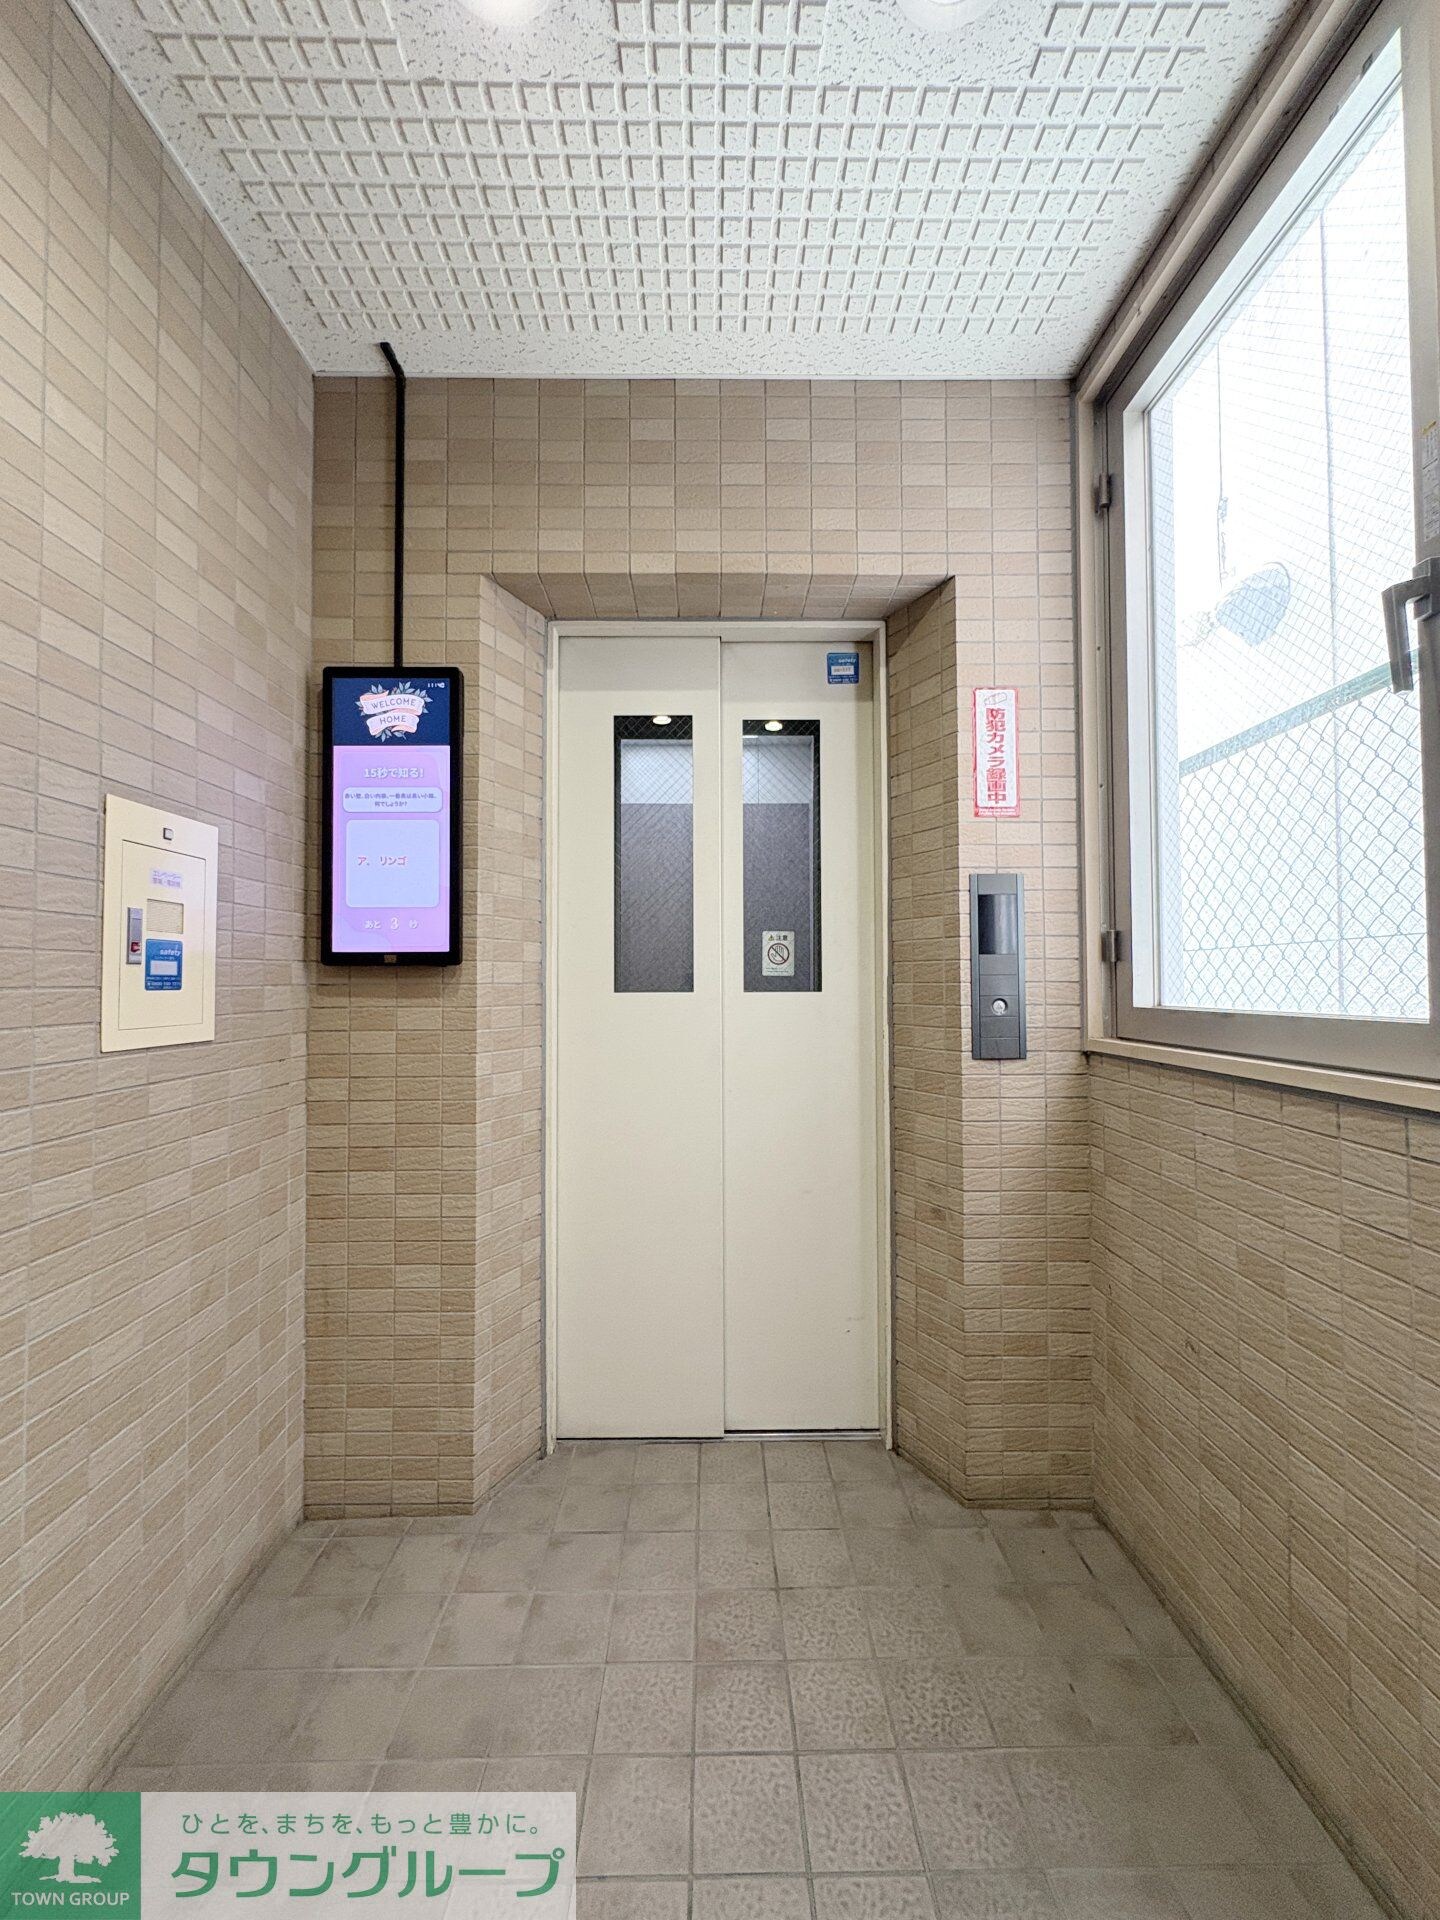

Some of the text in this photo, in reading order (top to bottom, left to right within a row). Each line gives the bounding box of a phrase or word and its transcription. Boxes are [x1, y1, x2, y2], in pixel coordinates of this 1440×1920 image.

[371, 698, 416, 711] WELCOME
[380, 715, 407, 725] HOME
[986, 707, 1007, 804] 防犯カメラ録画中
[380, 856, 408, 866] リンゴ
[390, 917, 400, 931] 3
